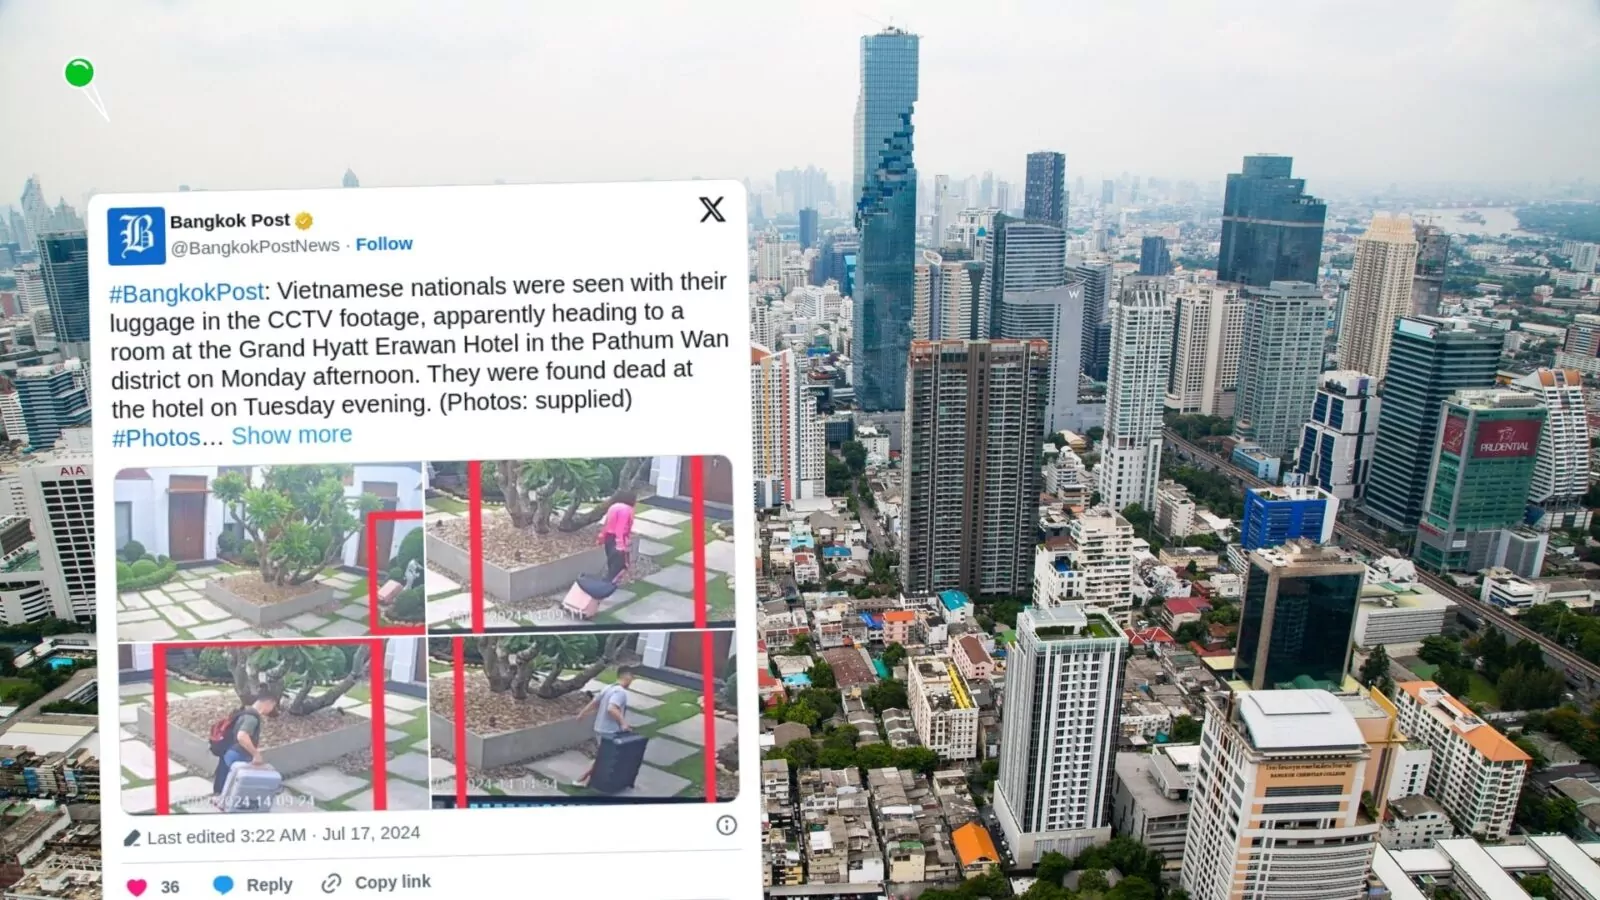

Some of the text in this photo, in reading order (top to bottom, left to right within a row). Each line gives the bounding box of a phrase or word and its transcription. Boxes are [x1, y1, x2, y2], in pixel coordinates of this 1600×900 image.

[1069, 290, 1080, 299] W
[1480, 441, 1529, 452] PRUDENTIAL
[60, 466, 86, 476] AIA
